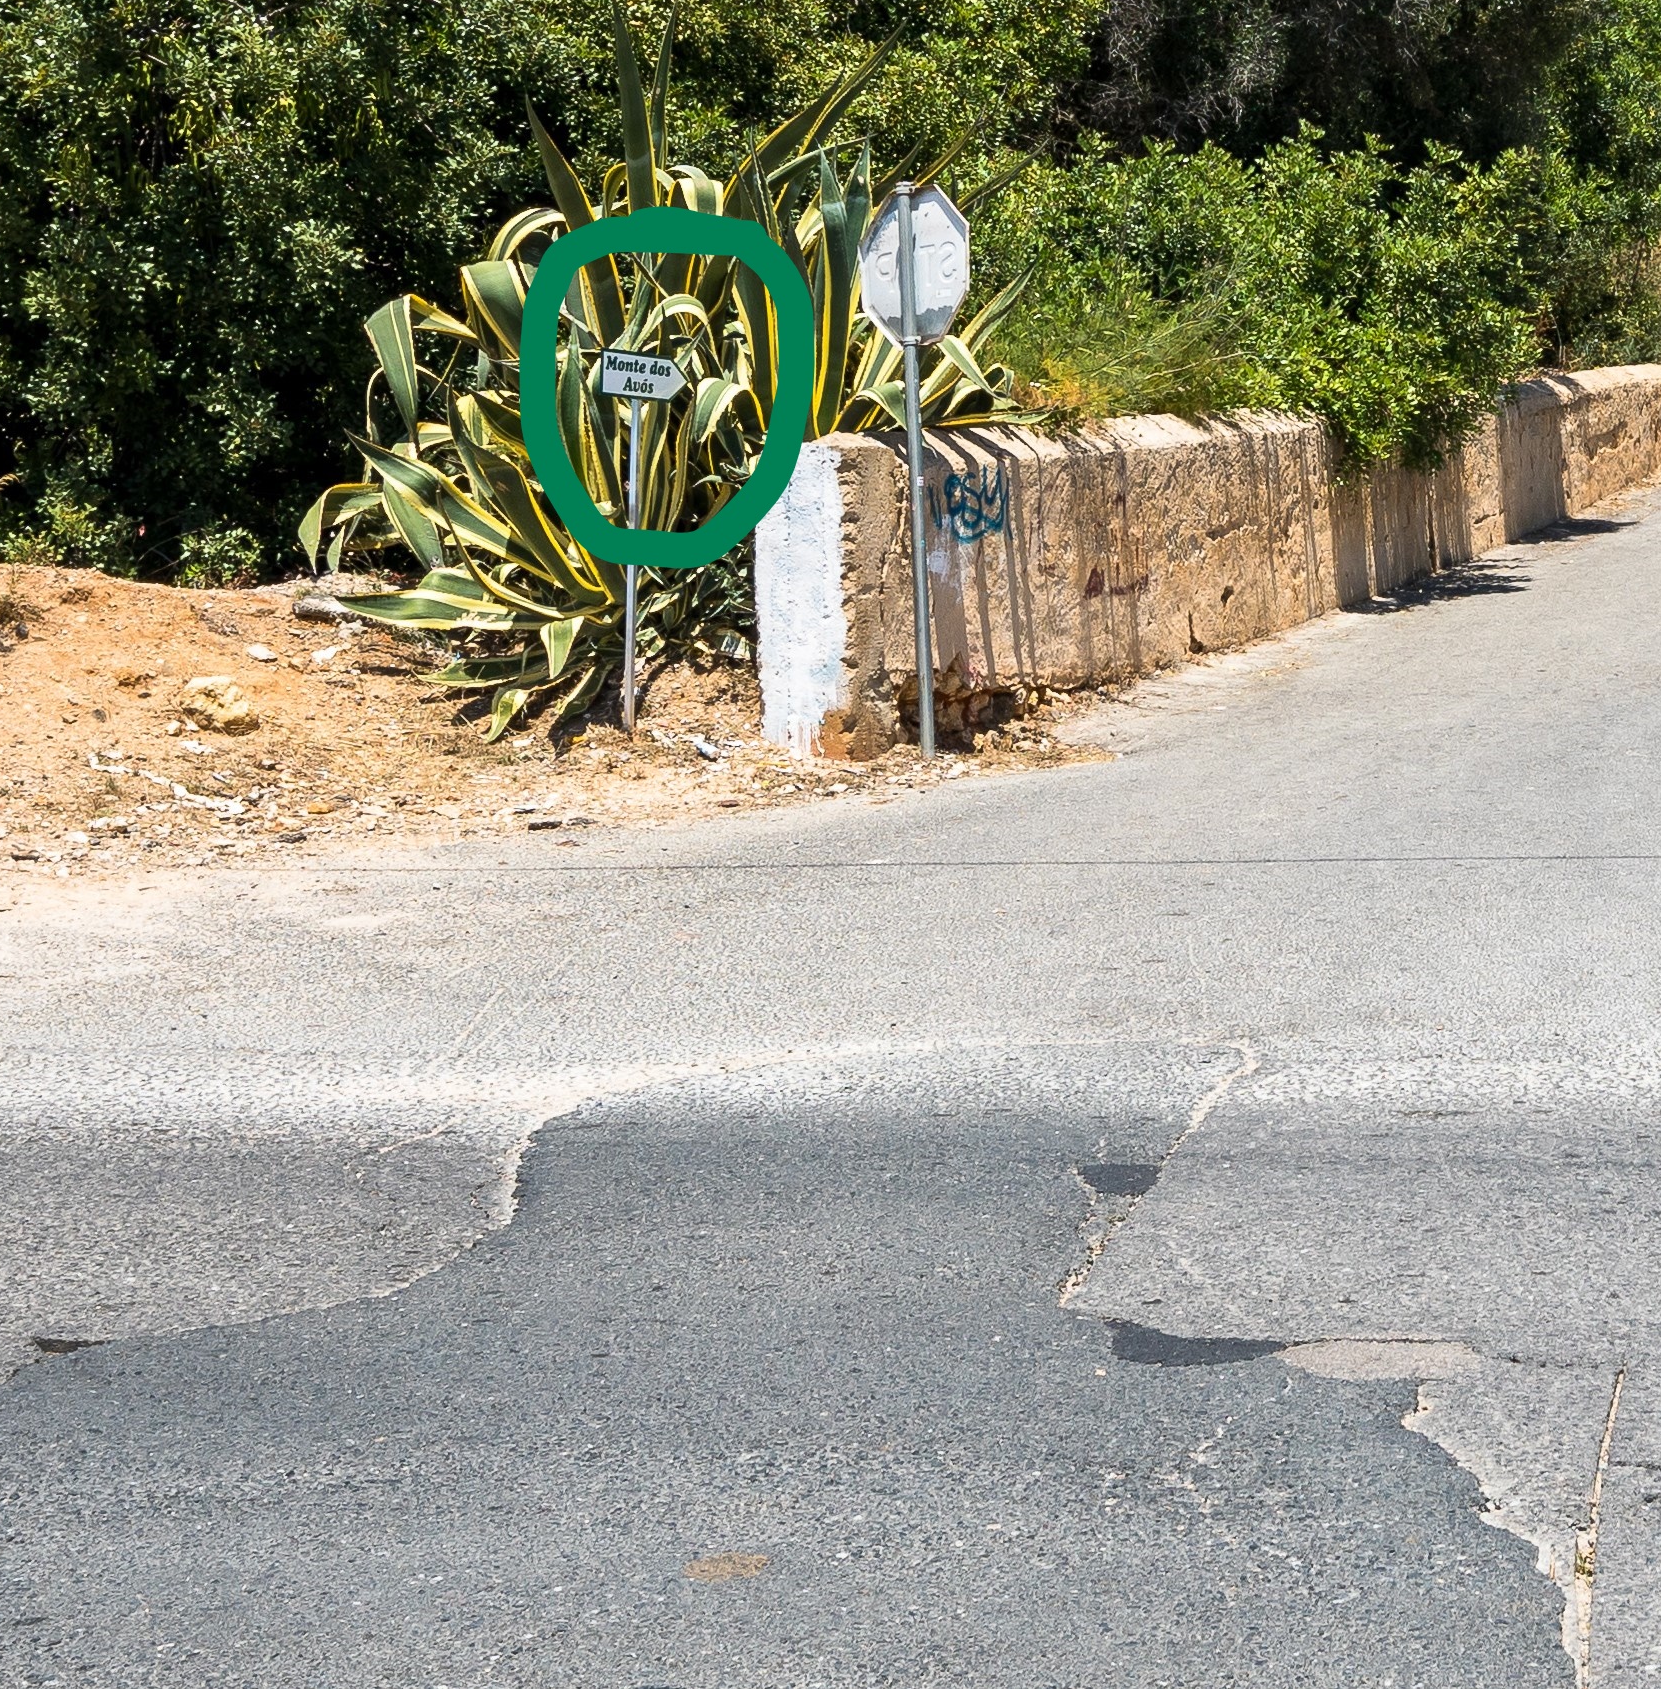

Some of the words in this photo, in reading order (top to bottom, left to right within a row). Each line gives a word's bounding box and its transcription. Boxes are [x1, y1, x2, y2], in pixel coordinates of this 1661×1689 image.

[605, 355, 647, 374] Monte
[649, 360, 672, 377] dos
[622, 376, 655, 394] Avós
